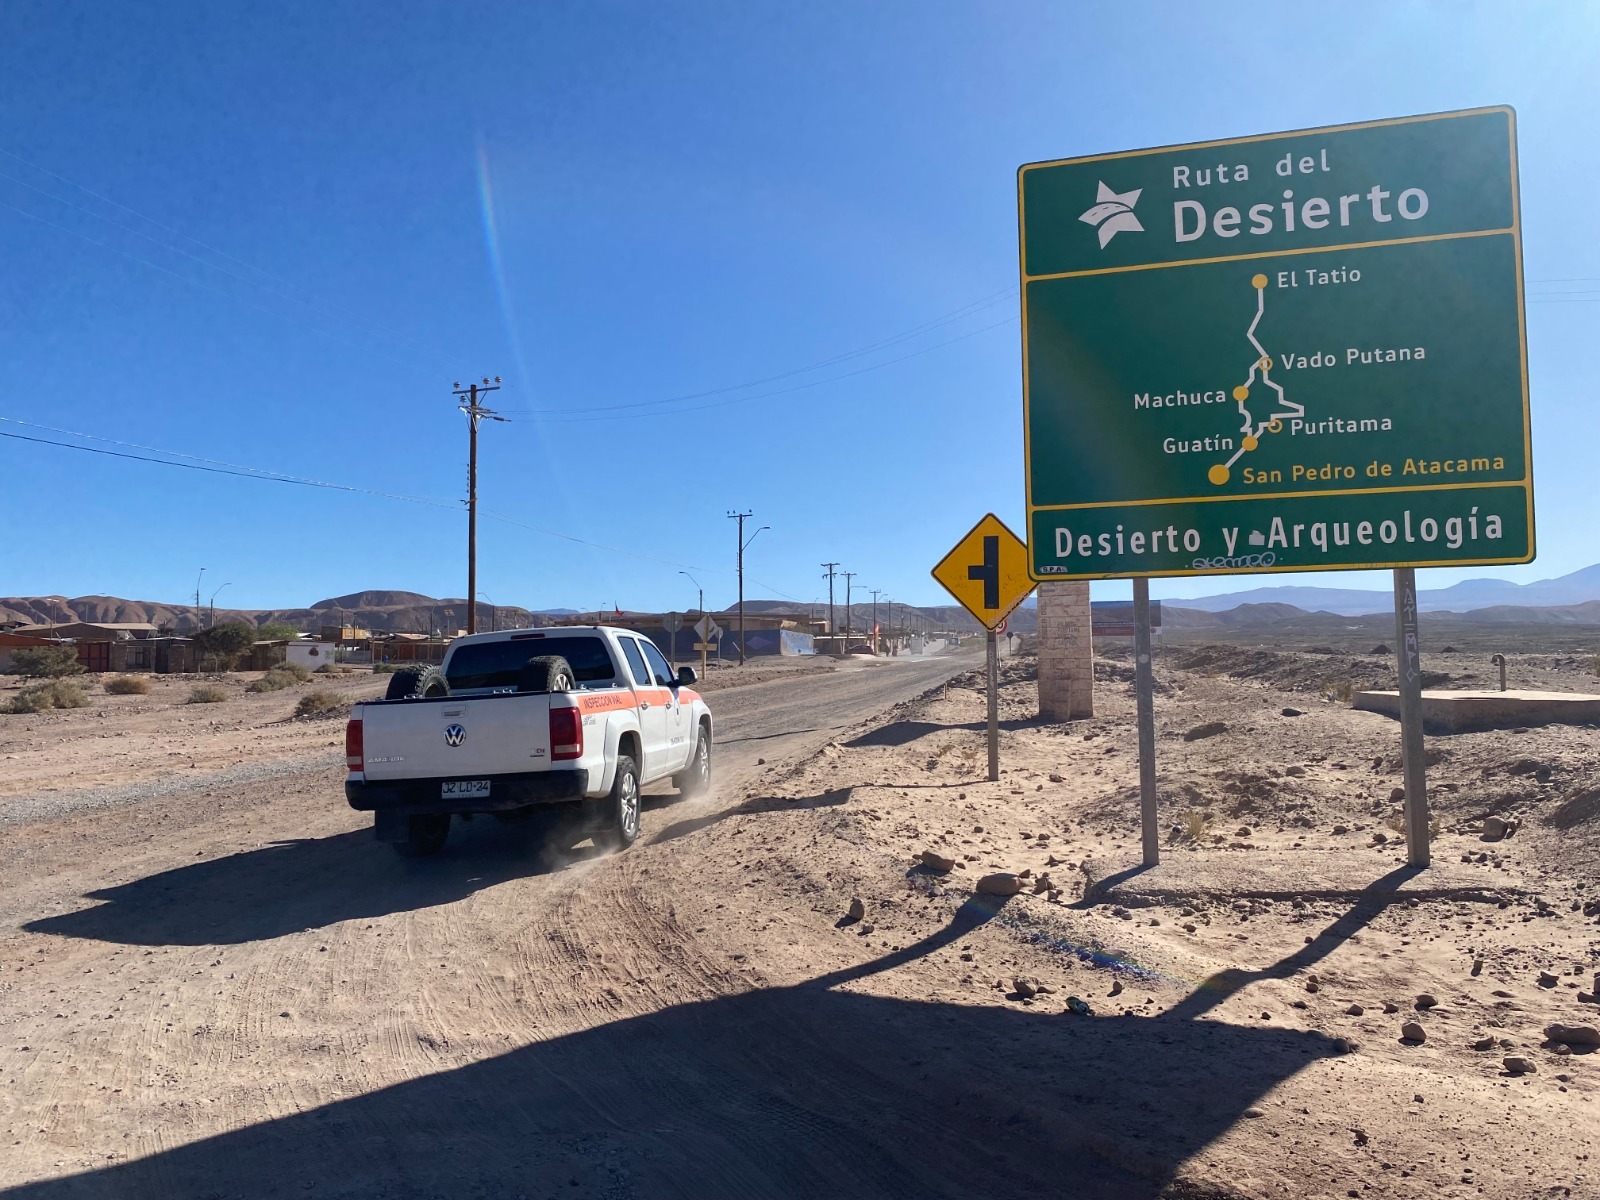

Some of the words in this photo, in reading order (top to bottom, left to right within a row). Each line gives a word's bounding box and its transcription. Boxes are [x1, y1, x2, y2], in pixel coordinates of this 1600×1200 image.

[1173, 163, 1249, 189] Ruta
[1275, 148, 1331, 177] del
[1173, 184, 1431, 243] Desierto
[1277, 271, 1298, 288] El
[1306, 266, 1361, 286] Tatio
[1281, 351, 1337, 370] Vado
[1346, 346, 1426, 366] Putana
[1134, 390, 1226, 410] Machuca
[1291, 415, 1393, 436] Puritama
[1163, 434, 1233, 455] Guatín
[1243, 467, 1282, 484] San
[1292, 463, 1356, 482] Pedro
[1366, 460, 1392, 478] de
[1402, 456, 1505, 476] Atacama
[1055, 524, 1201, 558] Desierto
[1221, 527, 1239, 557] y
[1267, 506, 1503, 553] Arqueología
